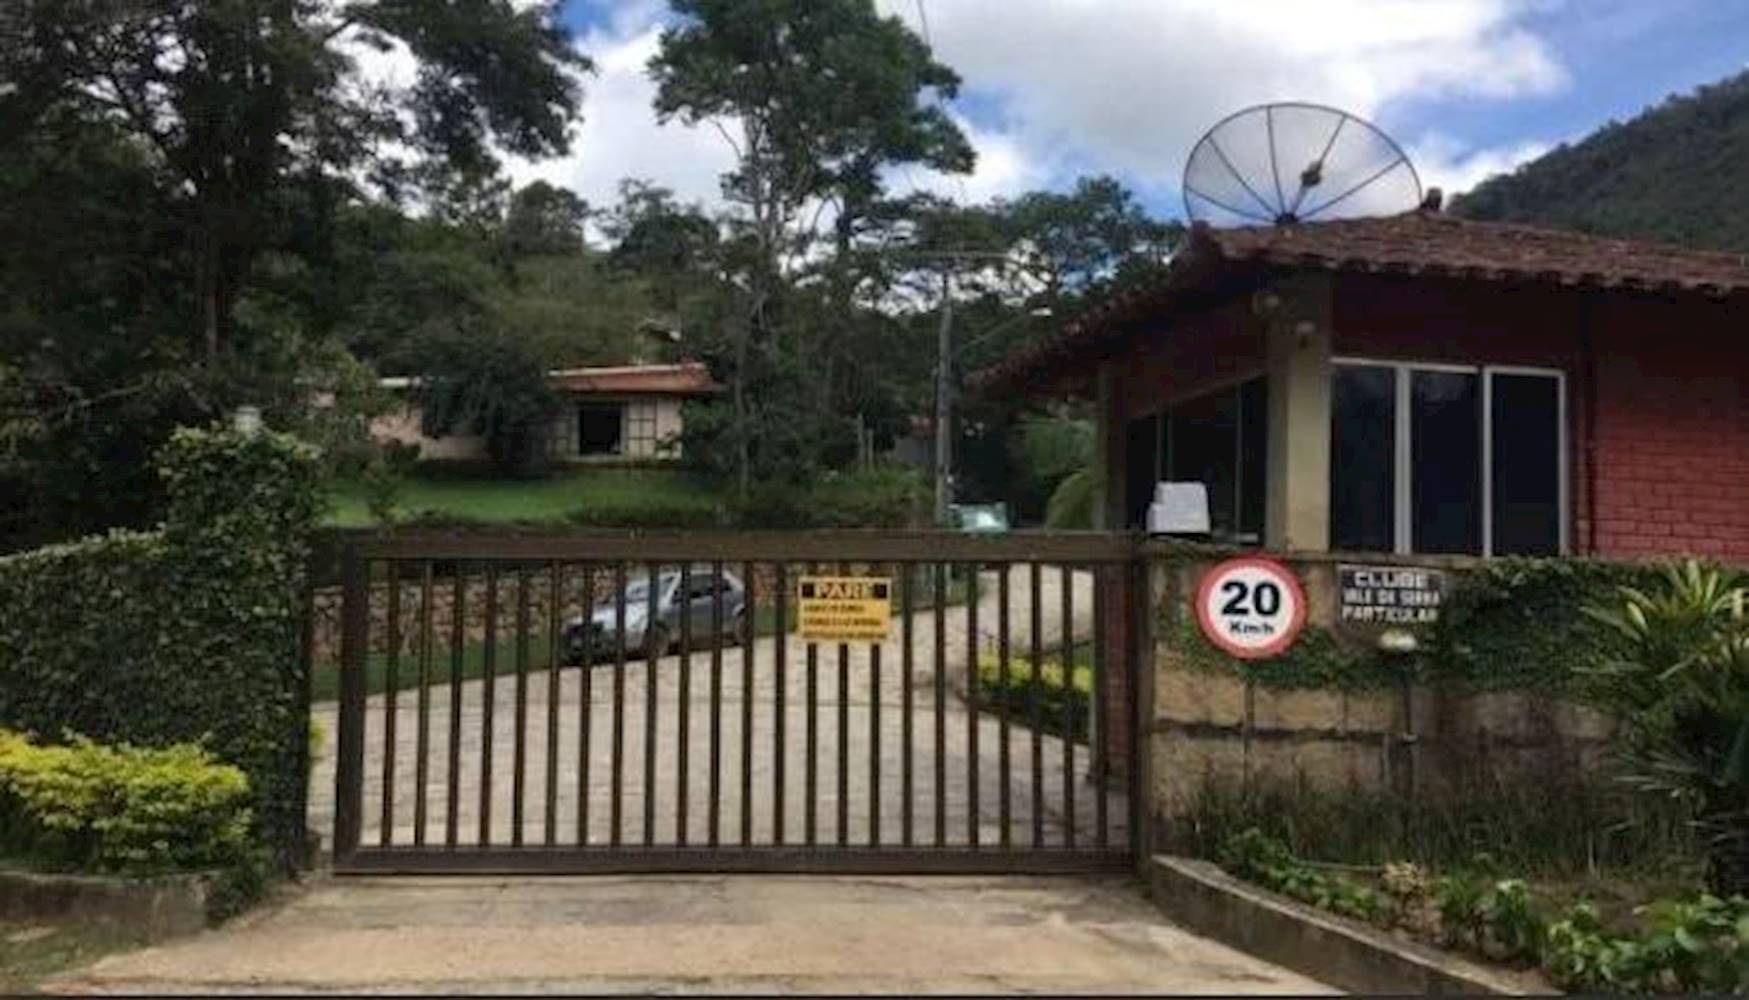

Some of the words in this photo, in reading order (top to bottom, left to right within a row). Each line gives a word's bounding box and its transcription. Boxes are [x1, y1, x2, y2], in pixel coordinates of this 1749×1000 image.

[1354, 572, 1428, 588] CLUBE
[1221, 580, 1280, 616] 20
[1342, 605, 1439, 623] PARTICULAR
